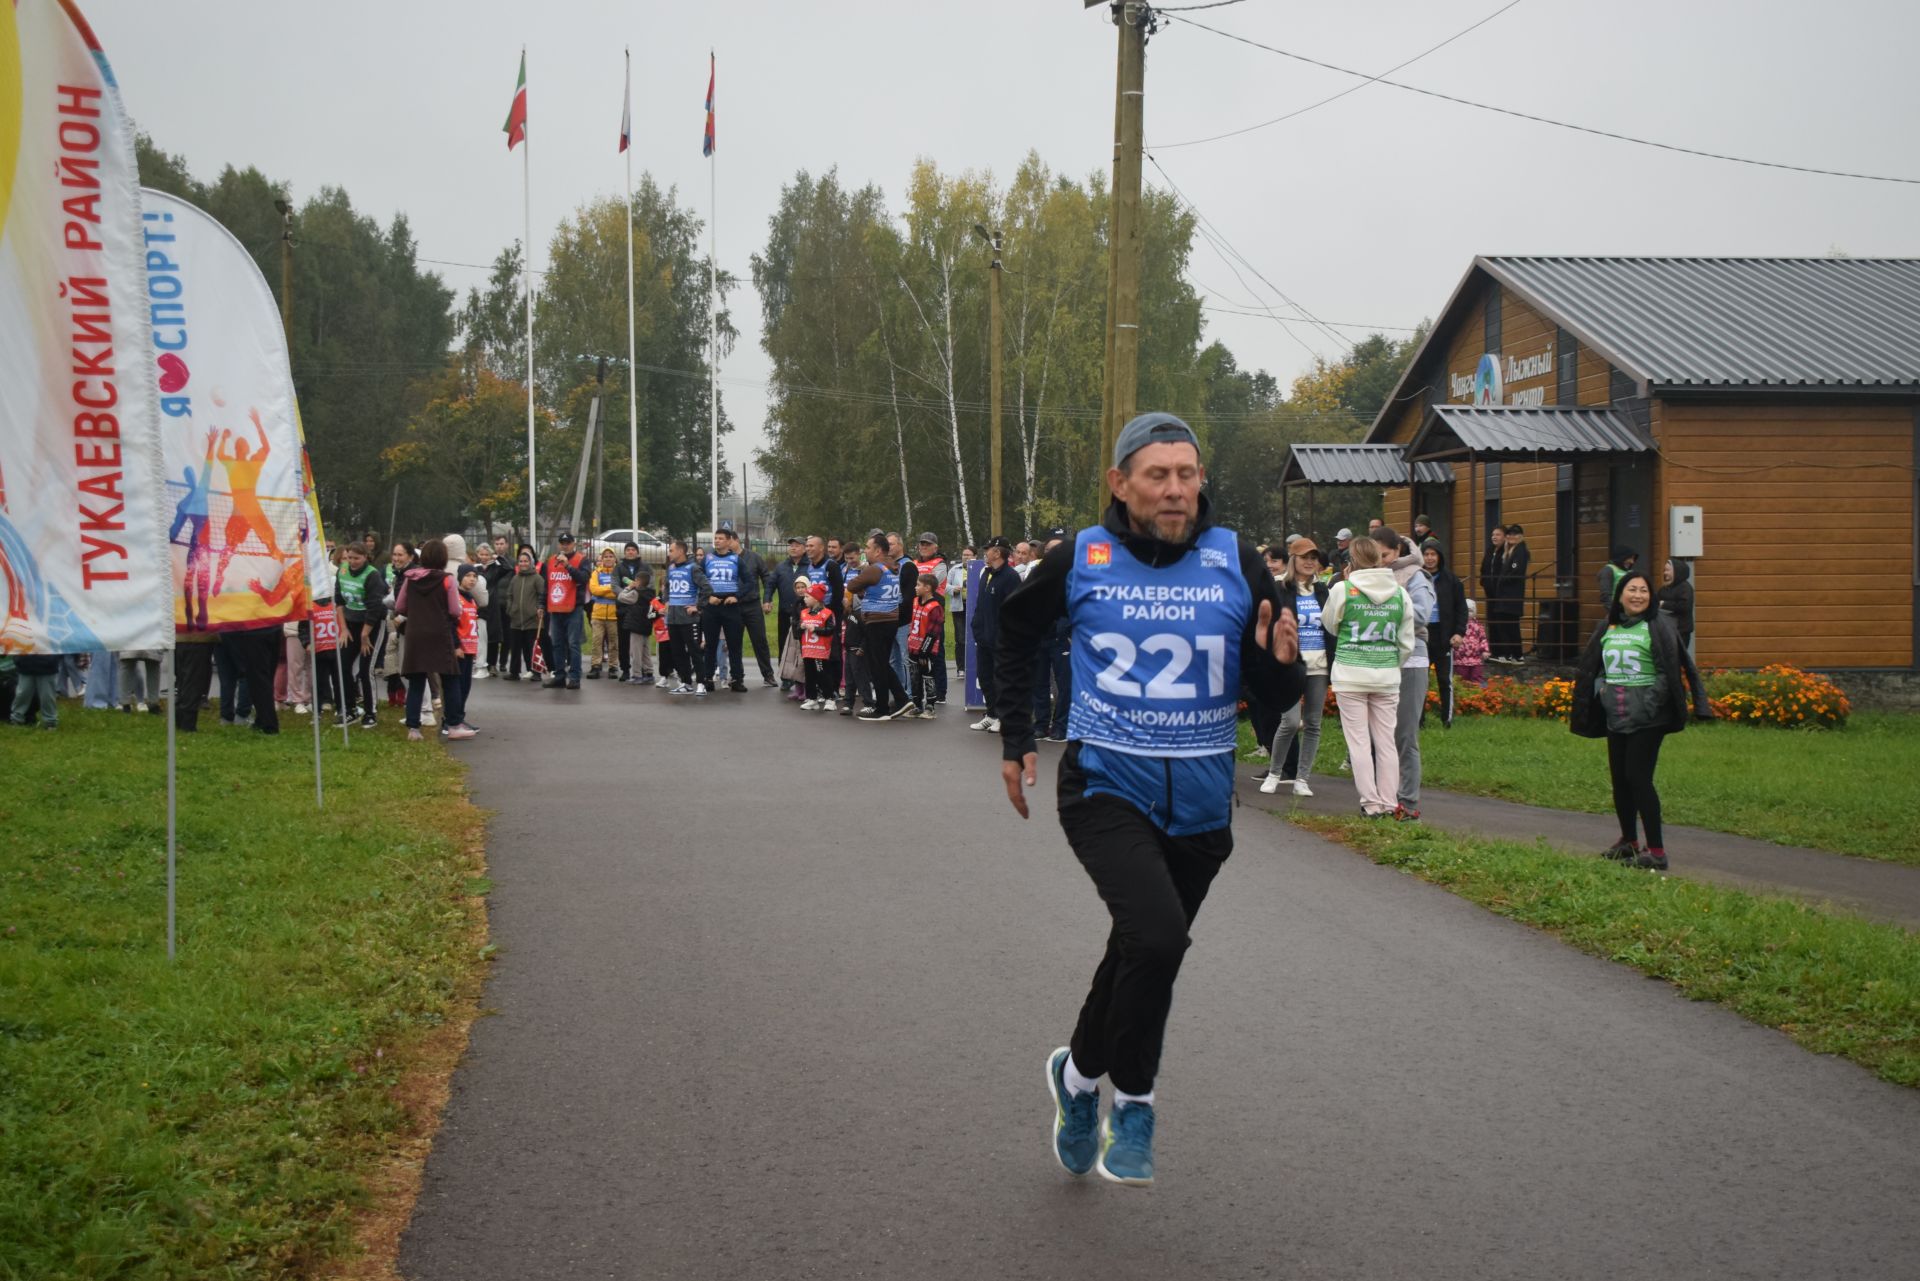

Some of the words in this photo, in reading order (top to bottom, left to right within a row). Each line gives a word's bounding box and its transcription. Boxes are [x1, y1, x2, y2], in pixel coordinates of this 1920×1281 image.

[54, 85, 103, 251] РАЙОН
[142, 213, 187, 350] СПОРТ!
[1505, 343, 1553, 383] Лыжный
[160, 397, 192, 418] Я
[58, 276, 129, 590] ТУКАЕВСКИЙ
[709, 568, 733, 581] 211
[1092, 585, 1224, 603] ТУКАЕВСКИЙ
[1122, 603, 1195, 620] РАЙОН
[1363, 609, 1390, 617] РАЙОН
[1090, 632, 1225, 698] 221
[1131, 710, 1196, 726] НОРМА
